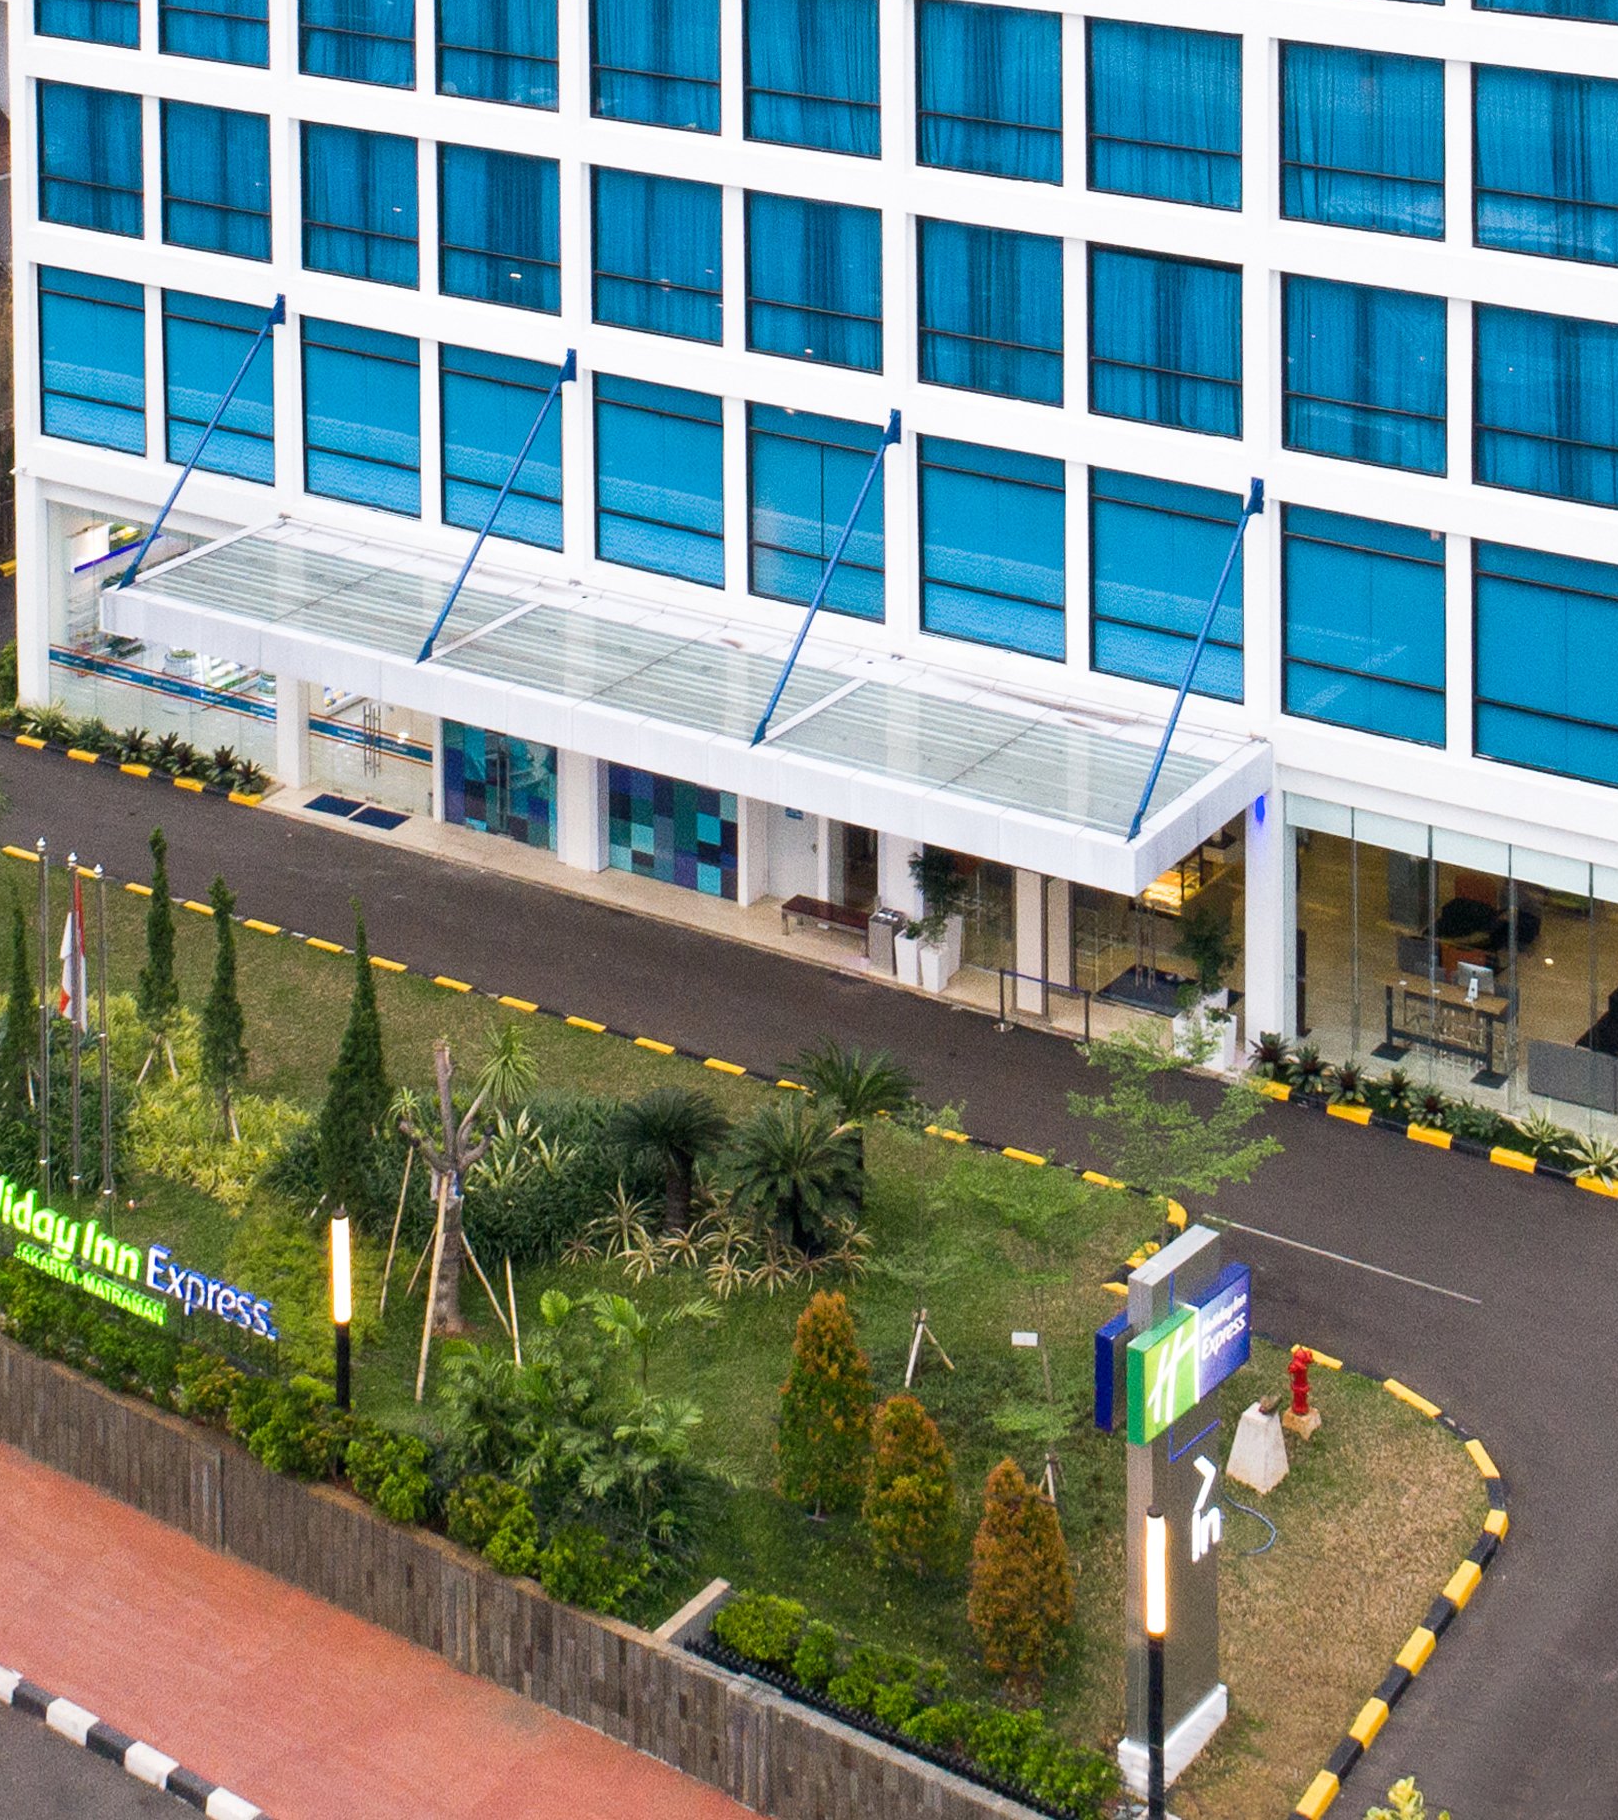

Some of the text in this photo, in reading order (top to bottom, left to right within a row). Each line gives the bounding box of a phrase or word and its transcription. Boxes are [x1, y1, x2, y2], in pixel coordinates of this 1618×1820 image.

[82, 1219, 143, 1281] Inn
[147, 1244, 274, 1338] Express
[1201, 1312, 1247, 1361] Express
